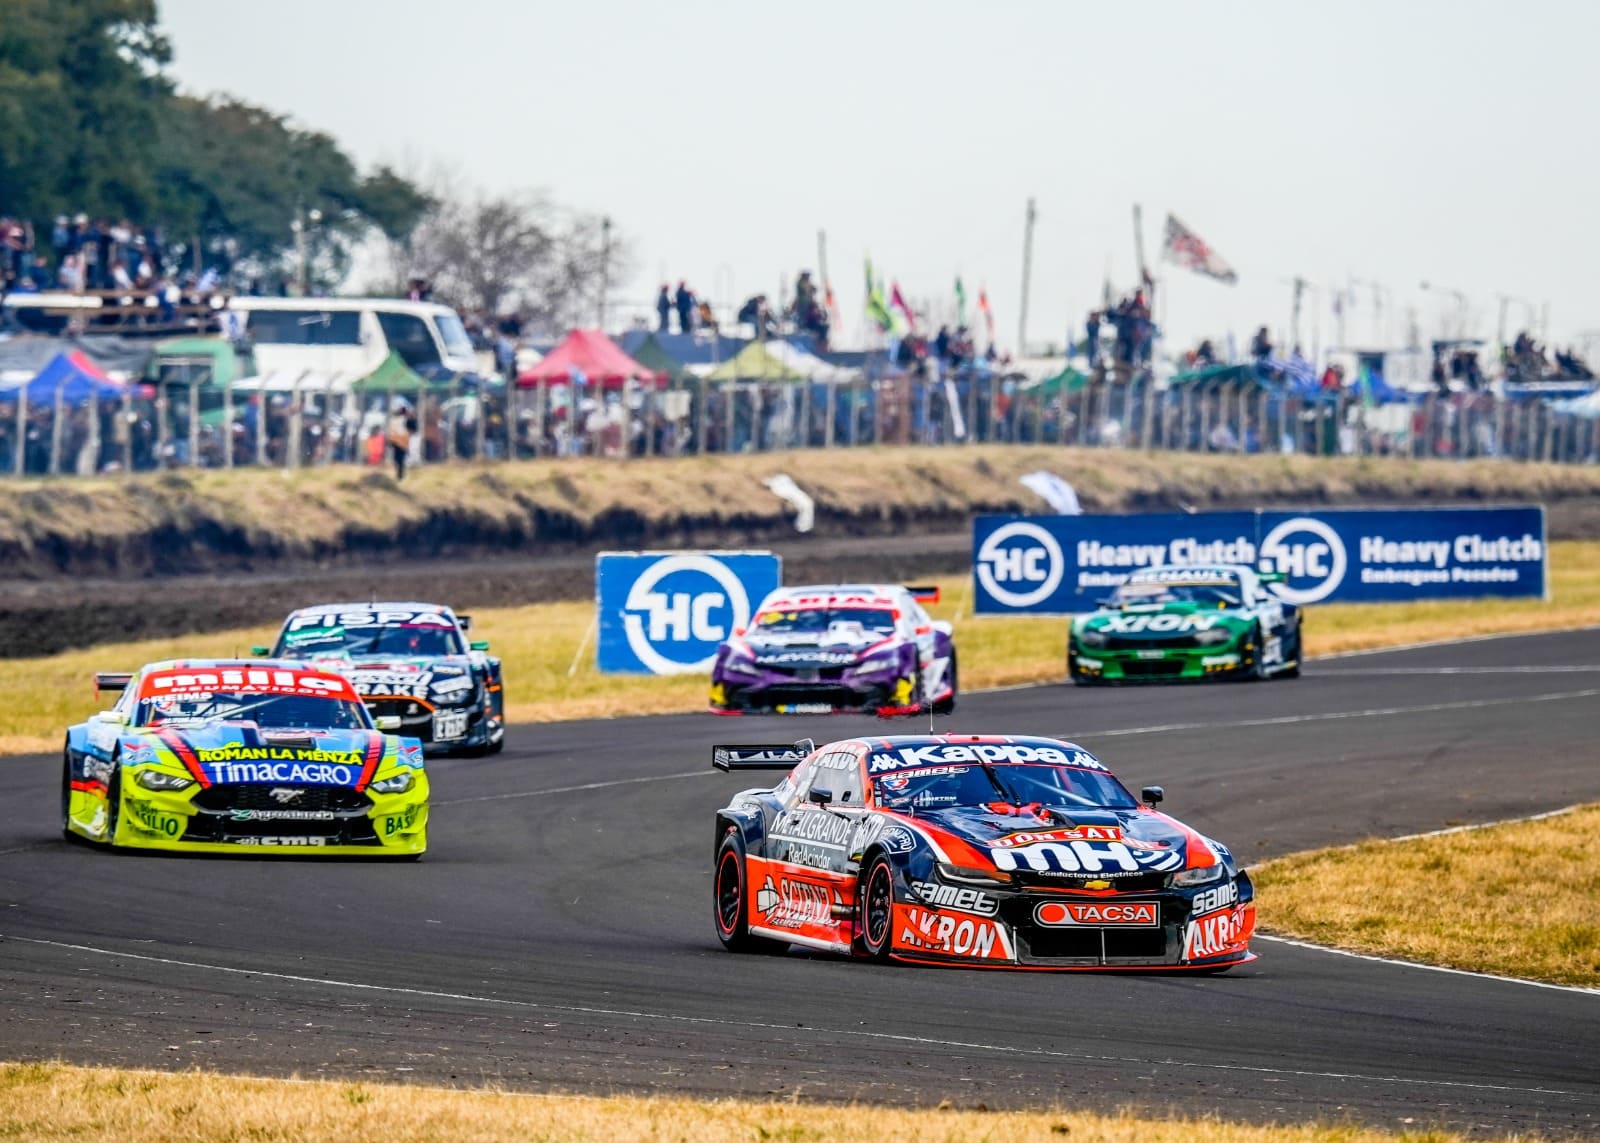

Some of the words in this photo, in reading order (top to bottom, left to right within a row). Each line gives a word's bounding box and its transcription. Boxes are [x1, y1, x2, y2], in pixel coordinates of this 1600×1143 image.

[1076, 539, 1167, 567] Heavy
[1169, 536, 1256, 566] Clutch
[1276, 542, 1330, 578] HC
[1359, 535, 1450, 569] Heavy
[1453, 533, 1543, 563] Clutch
[995, 547, 1047, 582] HC
[289, 611, 453, 632] FISPA
[648, 592, 725, 641] HC
[1099, 613, 1220, 633] XION
[154, 670, 343, 692] milla
[171, 684, 329, 695] NEUMATICOS
[354, 683, 429, 700] RAKE
[150, 691, 213, 702] REIMS
[199, 748, 267, 762] ROMAN
[270, 748, 294, 760] LA
[898, 743, 1067, 767] Kappa
[769, 809, 855, 845] METALGRANDE
[1038, 870, 1098, 880] Conductores
[905, 881, 996, 912] samet
[1192, 880, 1238, 916] same
[1074, 905, 1152, 921] TACSA
[901, 908, 996, 958] AKRON
